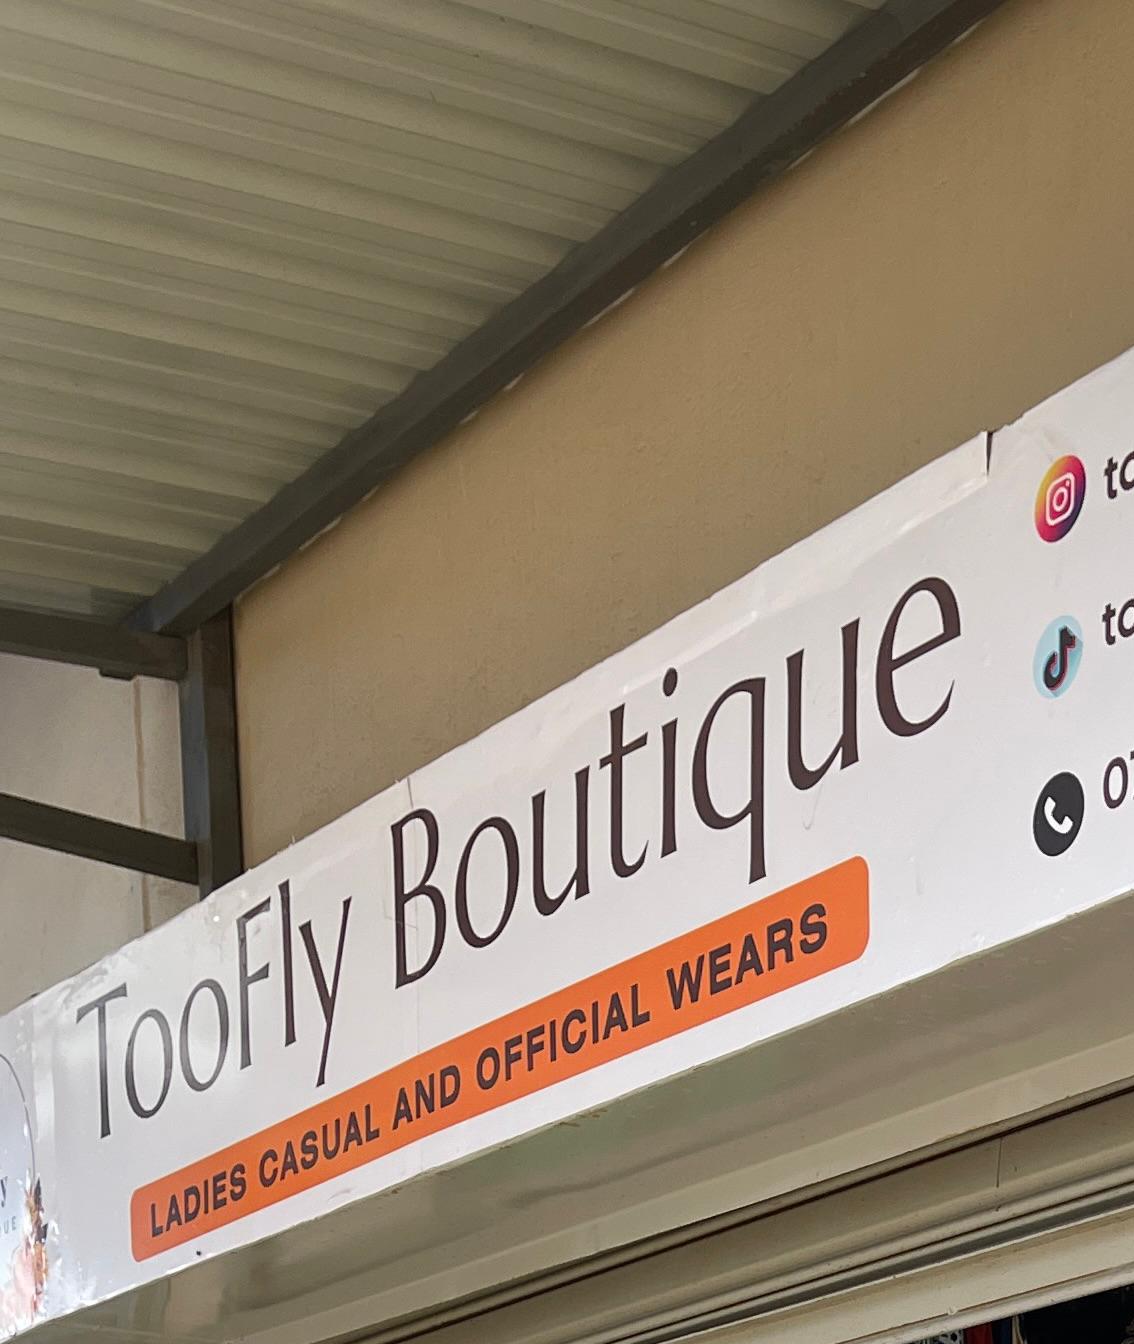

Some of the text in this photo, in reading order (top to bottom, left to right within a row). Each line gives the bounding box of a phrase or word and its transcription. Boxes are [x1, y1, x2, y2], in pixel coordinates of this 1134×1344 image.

[76, 577, 961, 1138] TooFly Boutique
[150, 903, 828, 1238] LADIES CASUAL AND OFFICIAL WEARS
